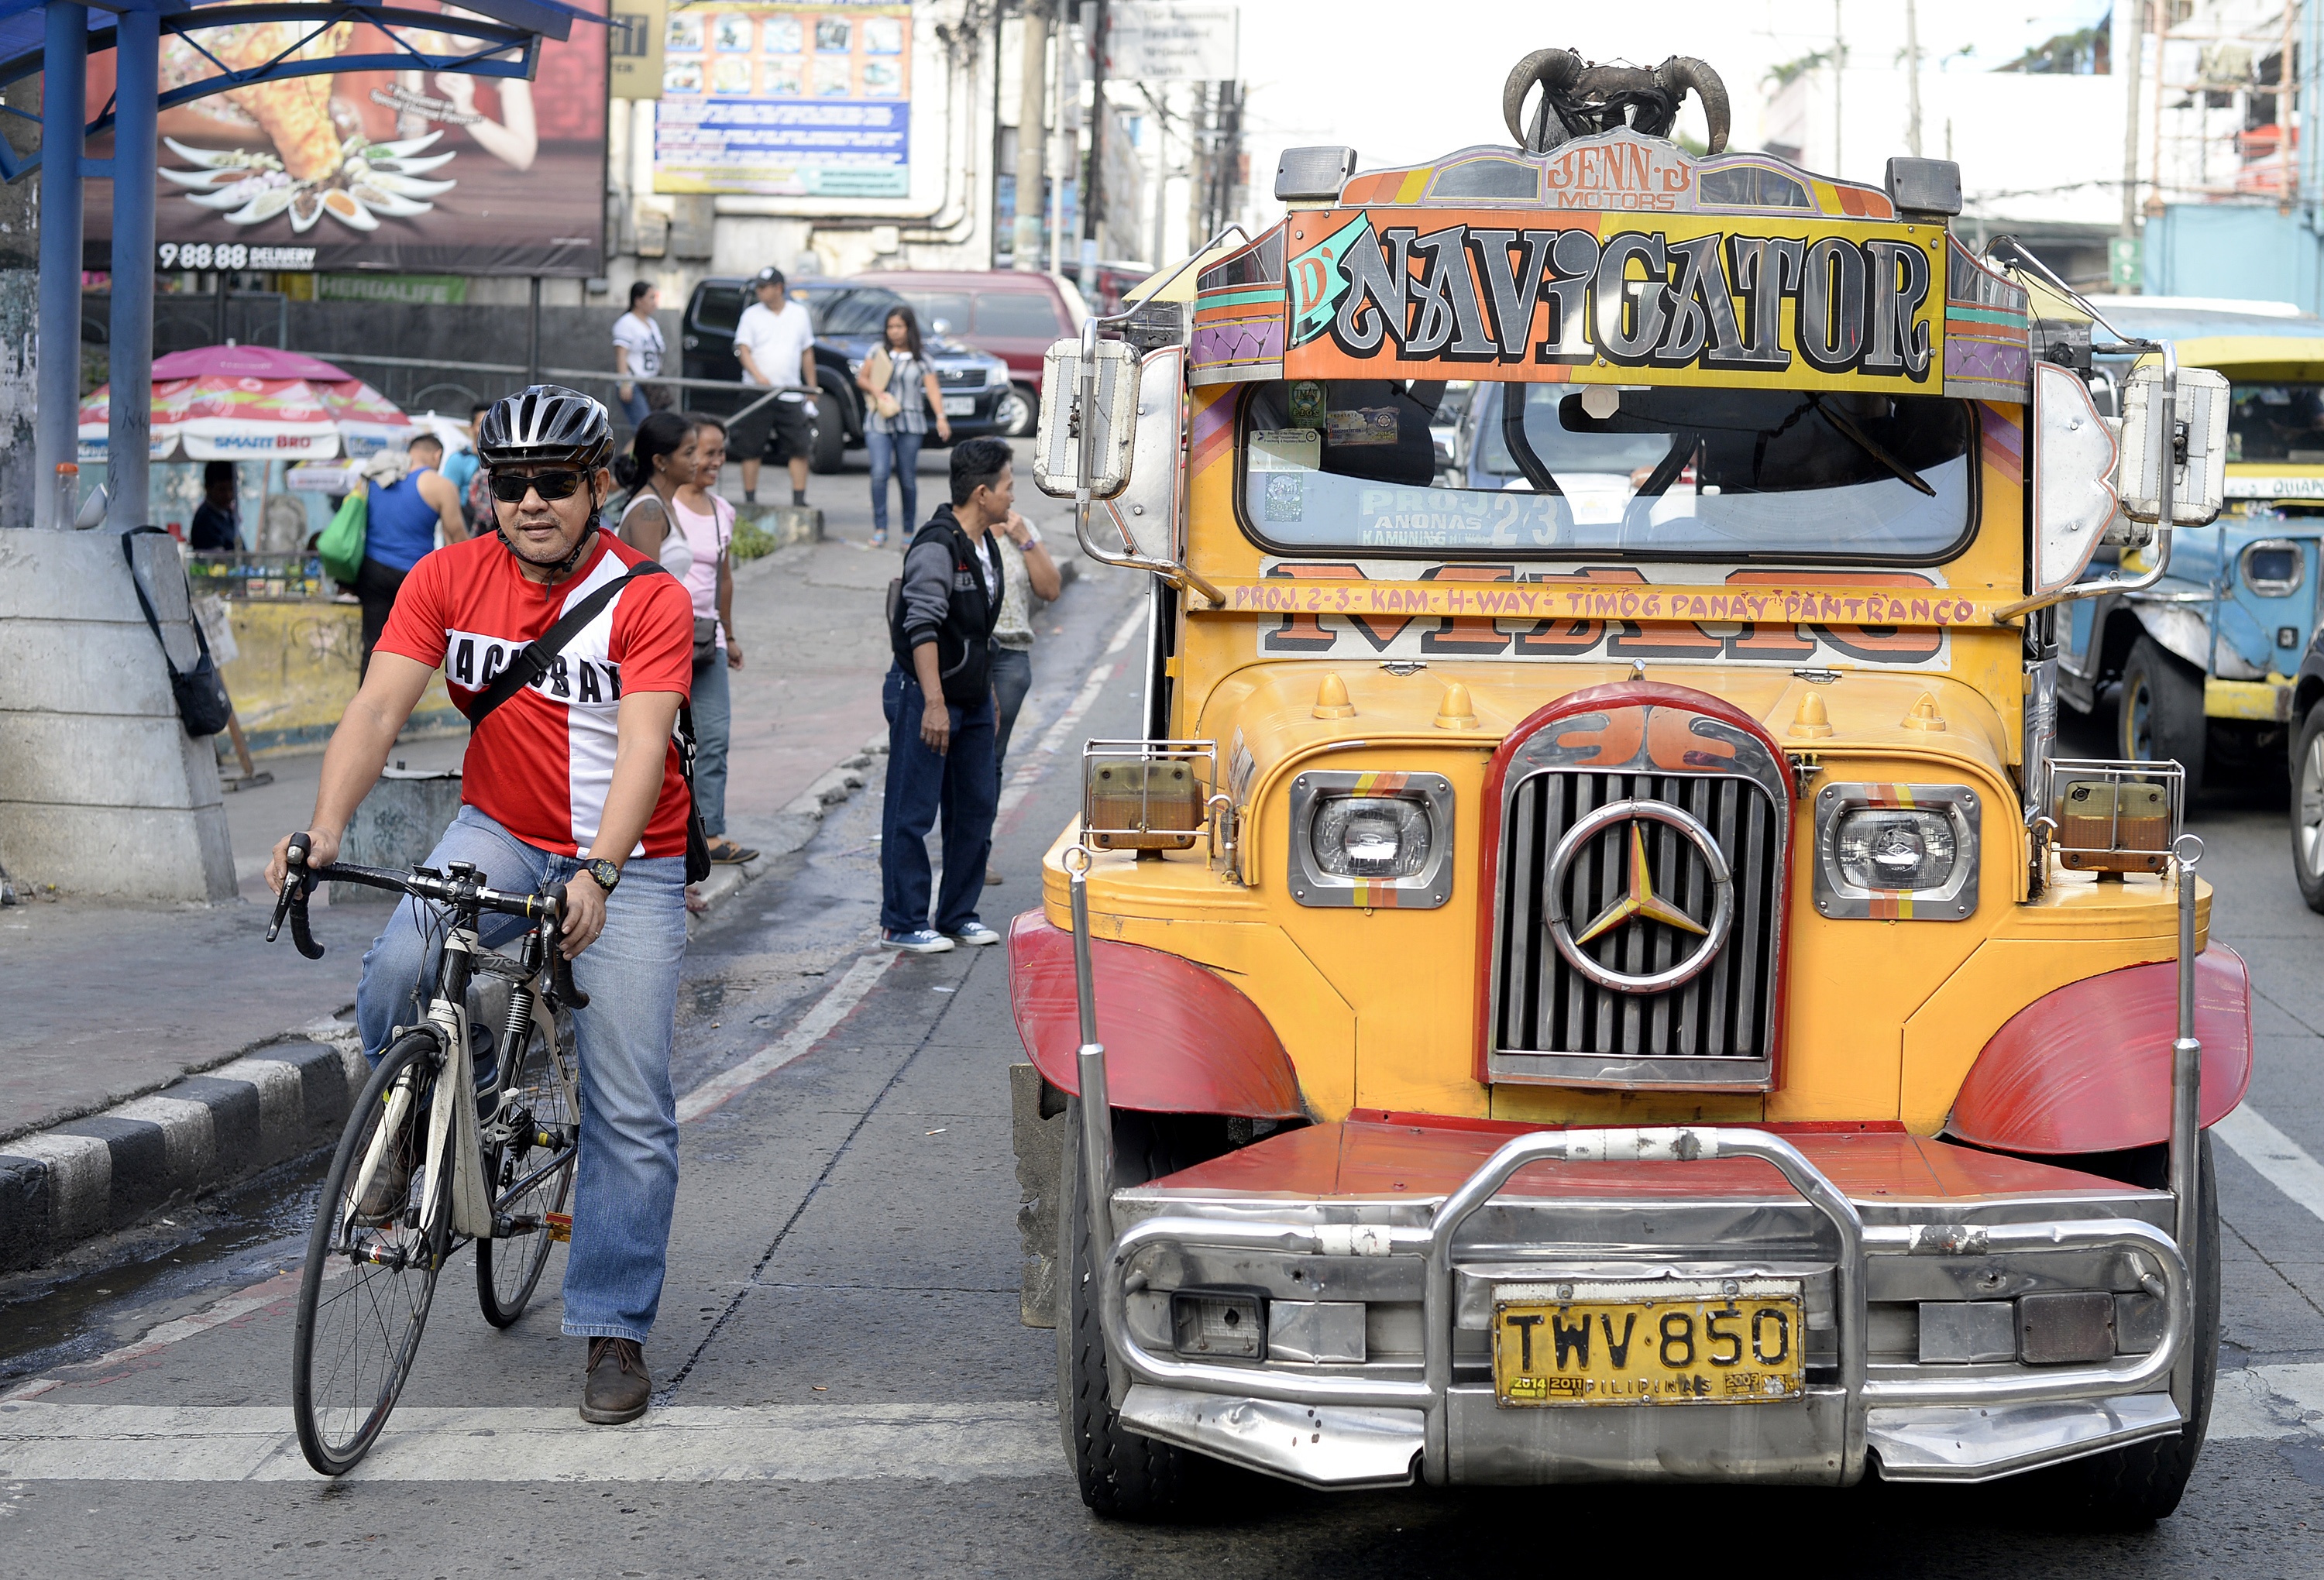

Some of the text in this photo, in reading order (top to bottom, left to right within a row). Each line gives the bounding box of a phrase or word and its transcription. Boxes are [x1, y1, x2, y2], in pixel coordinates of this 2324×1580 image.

[1558, 191, 1676, 210] MOTORS
[249, 247, 316, 263] DELIVERY
[1374, 514, 1482, 530] ANONAS
[1363, 530, 1446, 546] KAMUNING
[1566, 591, 1662, 618] TIMOG
[1671, 594, 1770, 621] PANAY
[1784, 594, 1974, 624] PANTRANCO
[1514, 1377, 1583, 1389] 2014 2011
